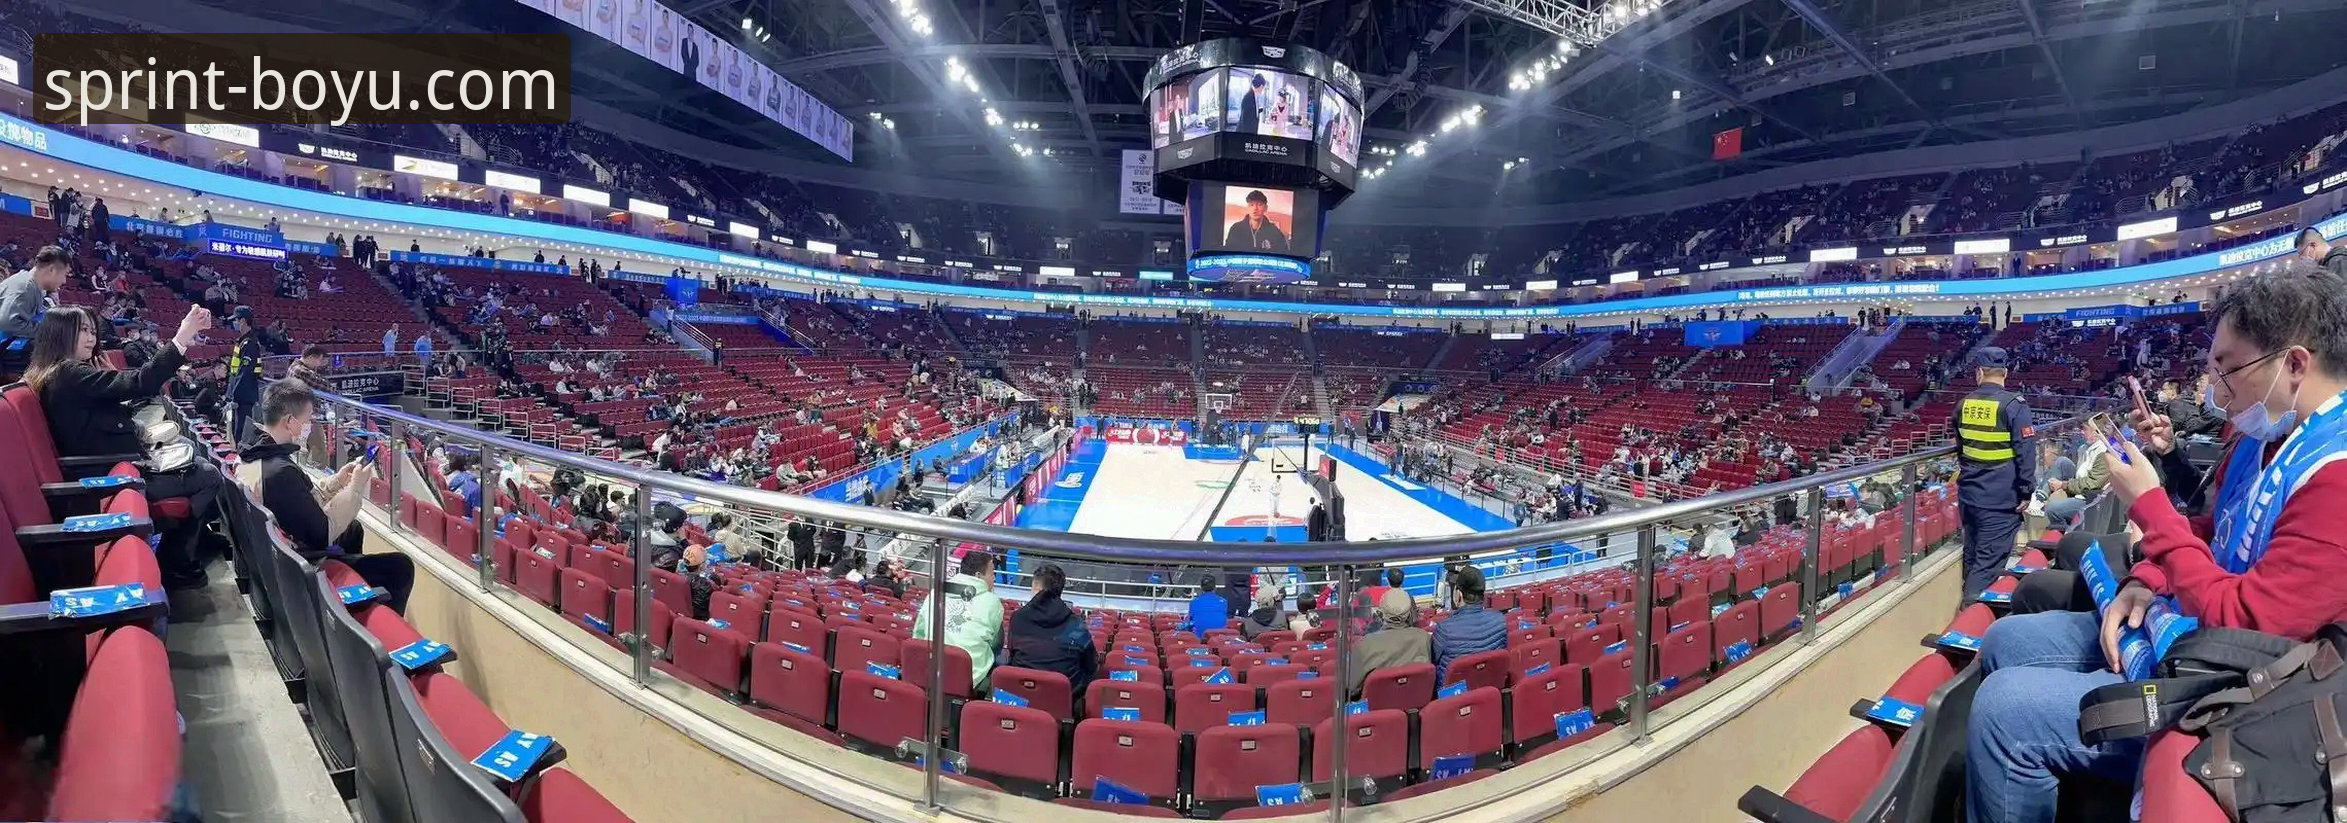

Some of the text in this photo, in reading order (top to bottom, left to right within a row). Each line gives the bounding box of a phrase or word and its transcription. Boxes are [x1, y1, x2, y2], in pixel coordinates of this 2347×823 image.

[1244, 142, 1288, 152] 凯迪拉克中心
[222, 228, 273, 244] FIGHTING
[2075, 308, 2116, 317] FIGHTING
